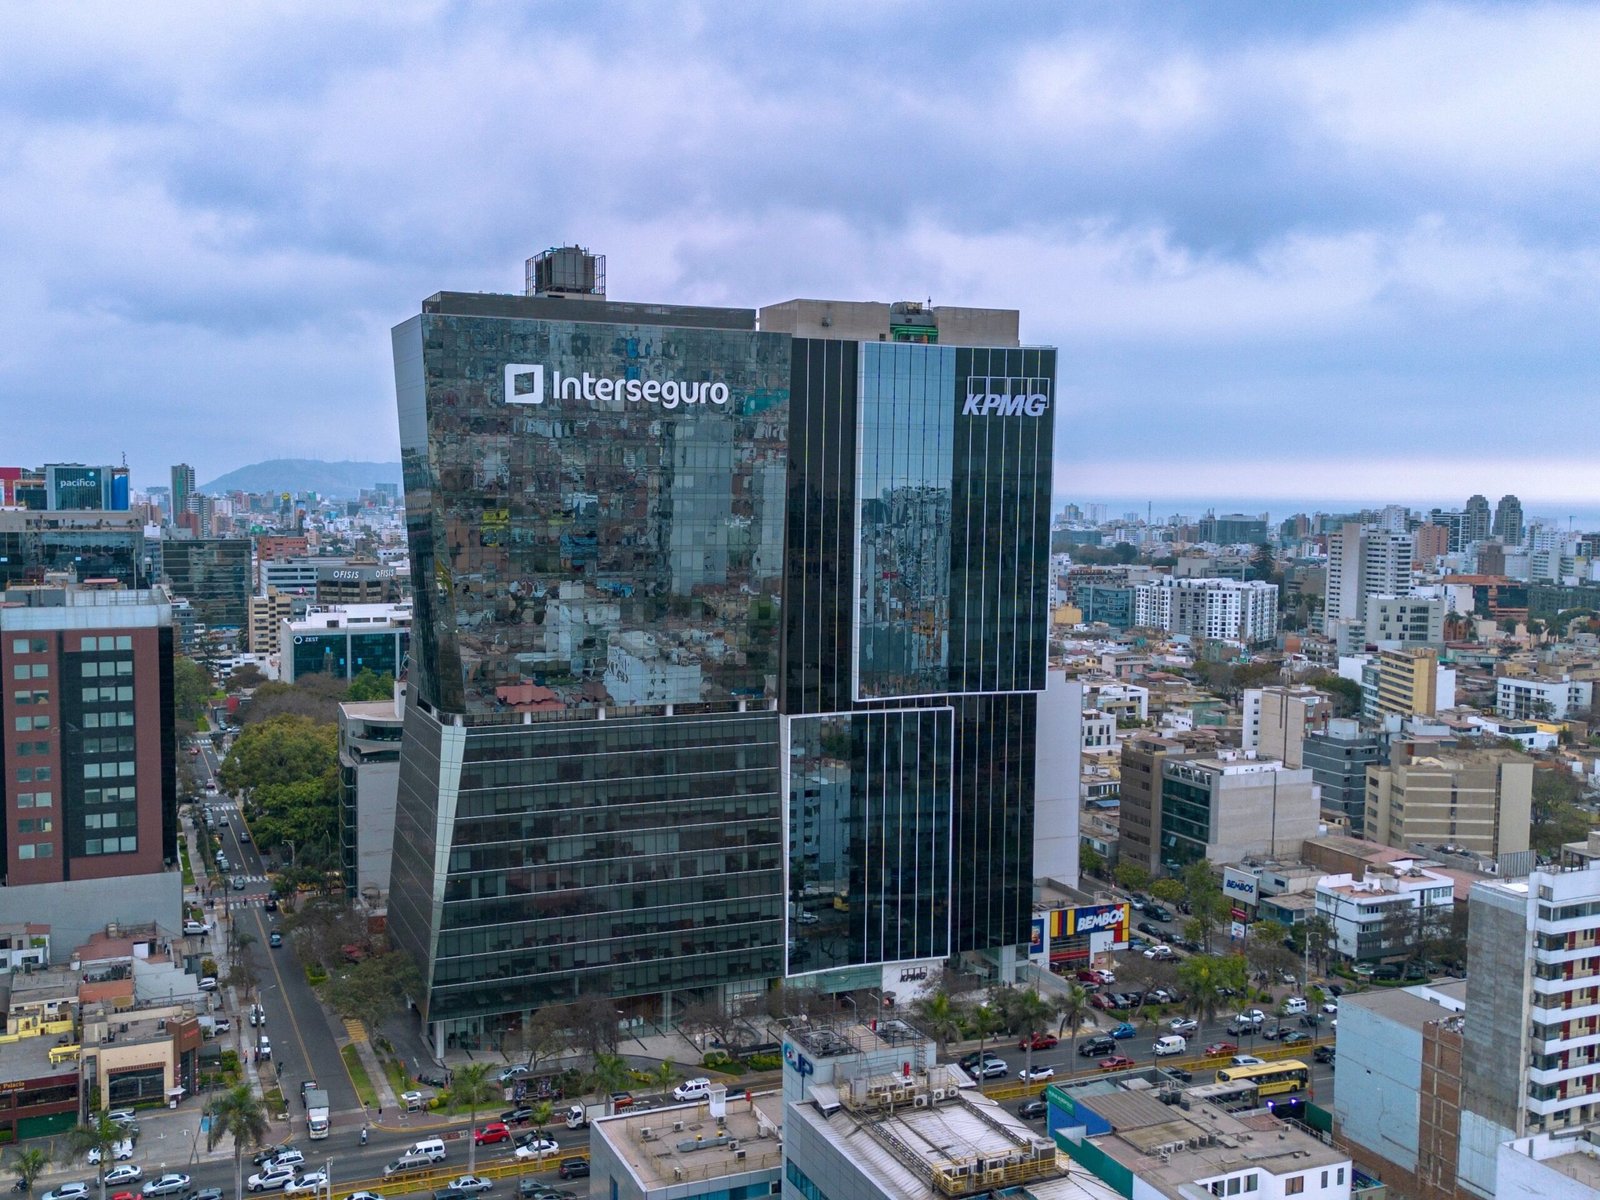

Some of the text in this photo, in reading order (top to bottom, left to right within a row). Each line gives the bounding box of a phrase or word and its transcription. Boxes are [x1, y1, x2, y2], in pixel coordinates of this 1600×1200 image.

[553, 371, 729, 409] Interseguro
[961, 393, 1048, 417] KPMG
[333, 570, 360, 579] OFISIS
[375, 569, 394, 578] OFISIS
[1226, 880, 1254, 894] BEMBOS
[1076, 907, 1125, 932] BEMBOS
